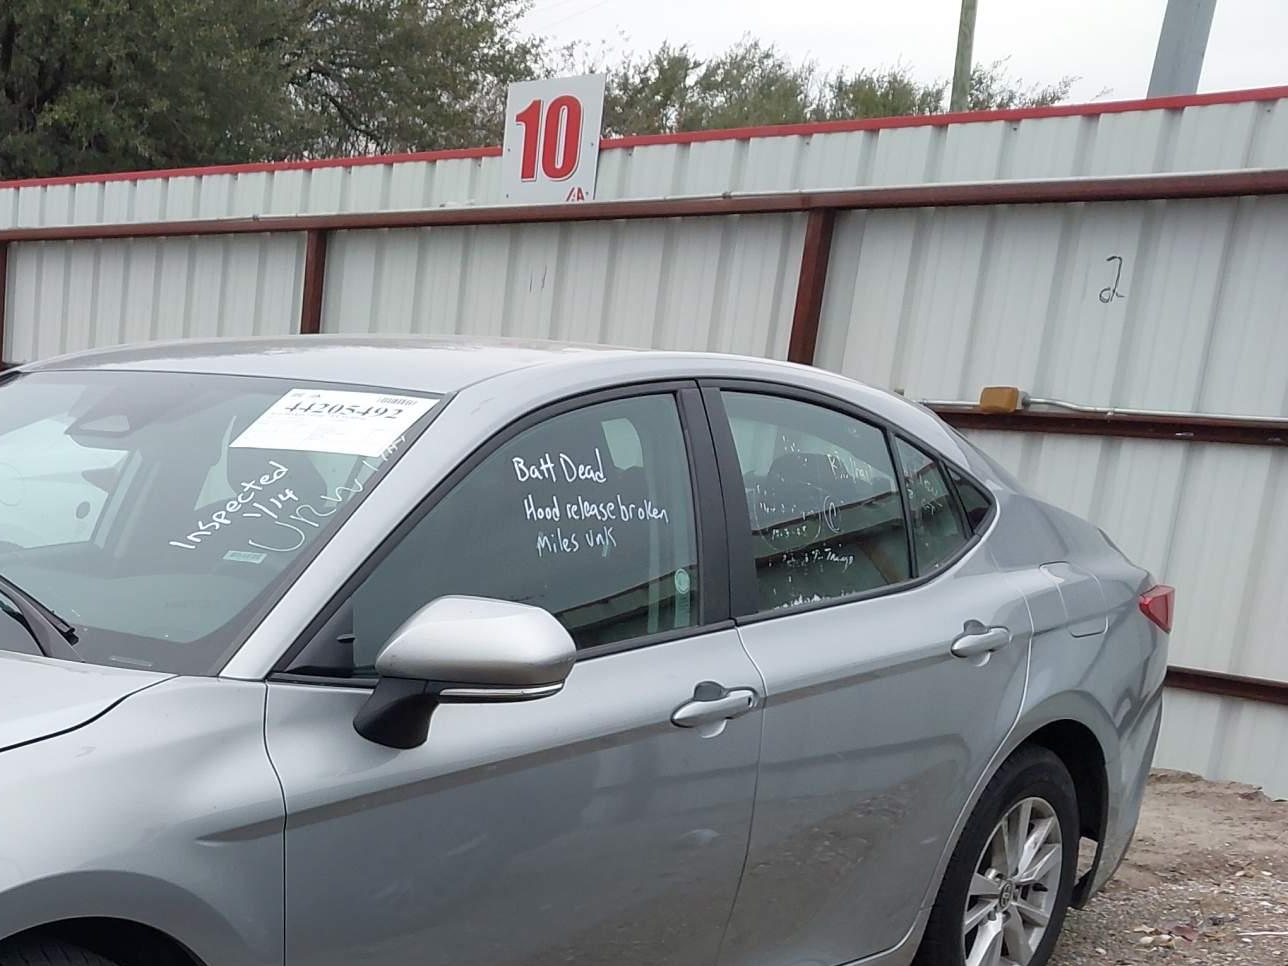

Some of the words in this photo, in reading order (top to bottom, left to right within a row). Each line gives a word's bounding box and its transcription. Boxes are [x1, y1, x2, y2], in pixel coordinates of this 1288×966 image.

[515, 95, 583, 182] 10
[1099, 255, 1125, 304] 2
[284, 401, 404, 420] 44205492
[512, 453, 557, 483] Batt
[559, 448, 607, 483] Dead
[169, 461, 289, 550] Inspected
[243, 488, 299, 519] 1/14
[523, 494, 561, 522] Hood
[566, 495, 616, 522] release
[617, 494, 669, 524] broken
